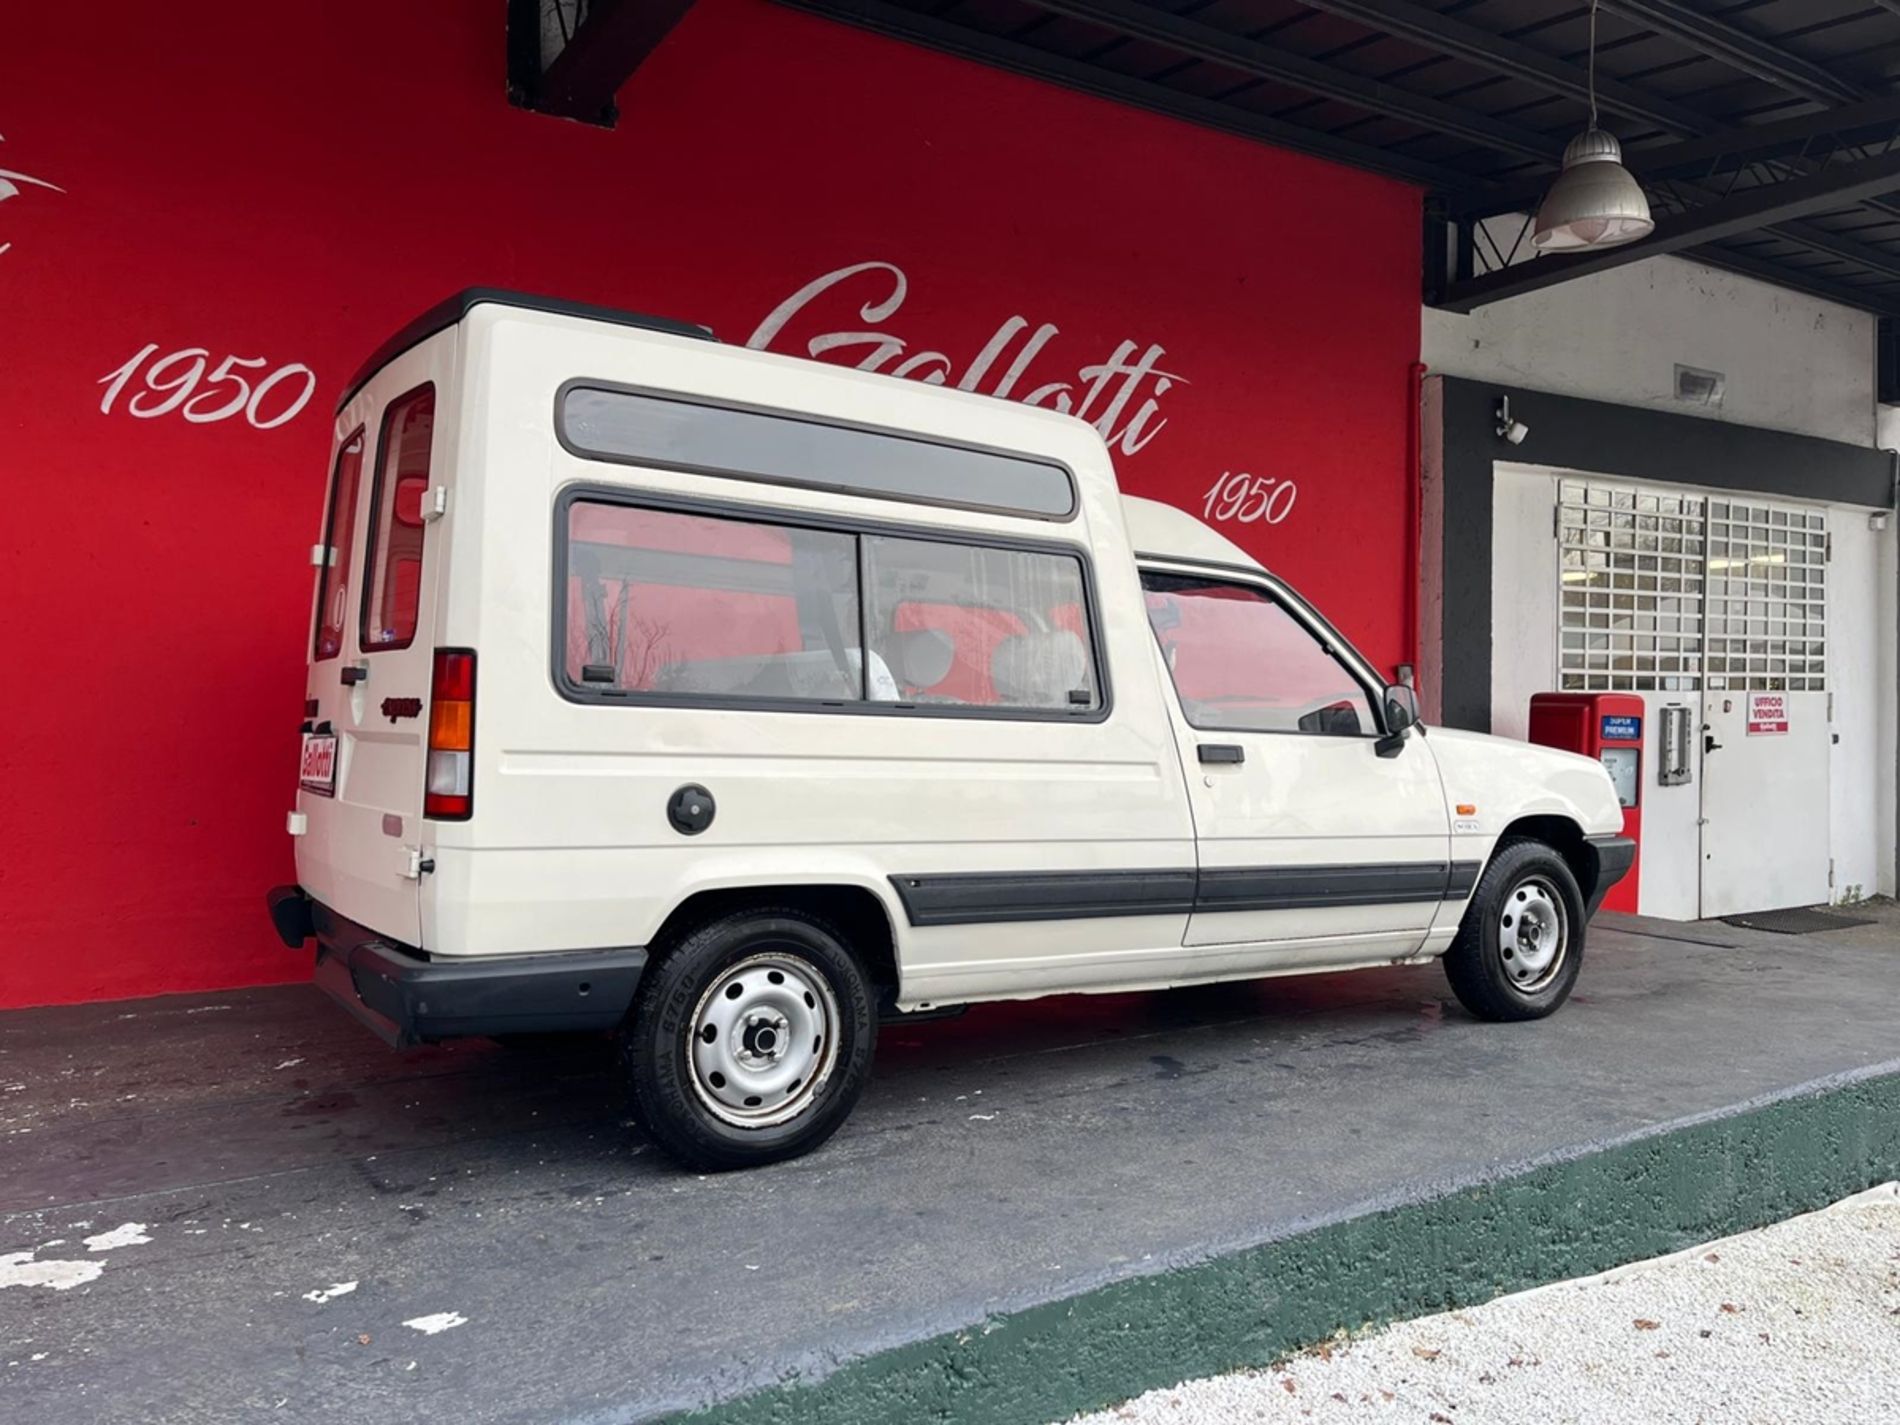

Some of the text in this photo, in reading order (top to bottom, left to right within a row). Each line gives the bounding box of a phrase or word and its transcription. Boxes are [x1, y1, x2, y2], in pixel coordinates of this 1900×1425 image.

[97, 343, 316, 429] 1950
[1203, 471, 1298, 524] 1950
[1754, 697, 1783, 707] UFFICIO
[1752, 709, 1784, 719] VENDITA
[1604, 725, 1635, 735] PREMIUM
